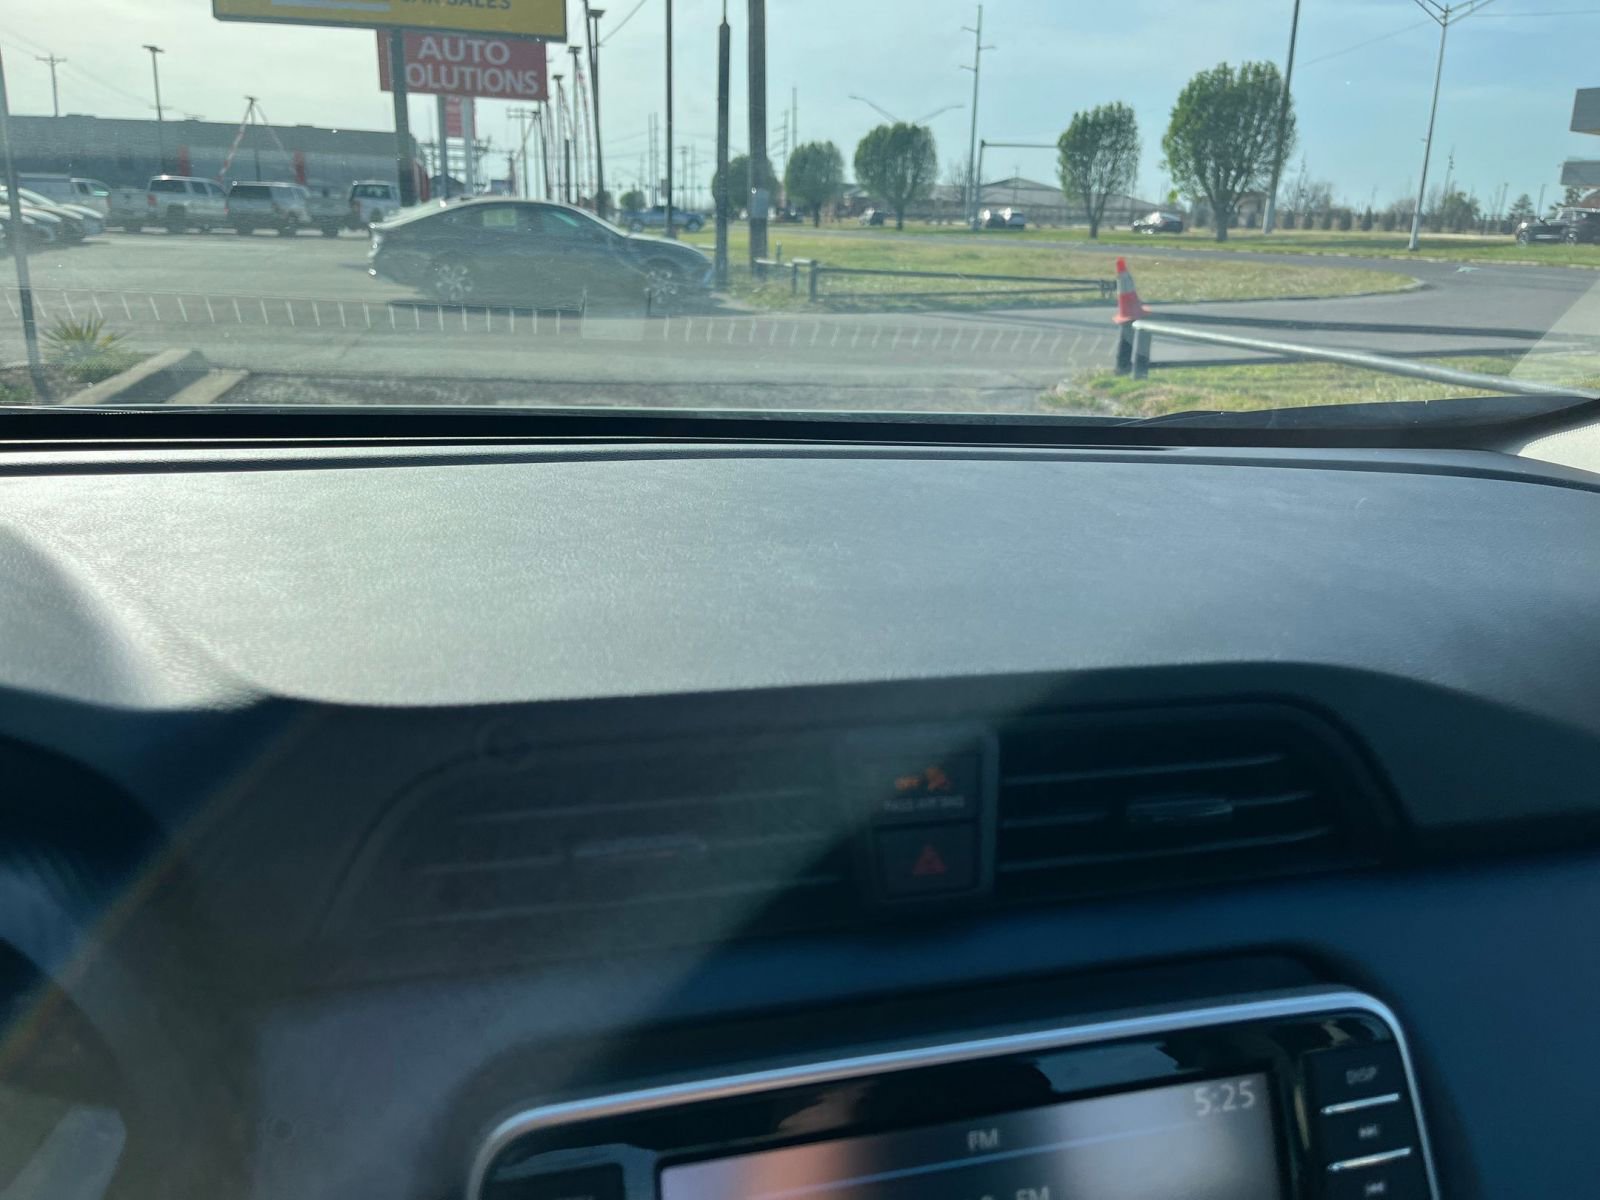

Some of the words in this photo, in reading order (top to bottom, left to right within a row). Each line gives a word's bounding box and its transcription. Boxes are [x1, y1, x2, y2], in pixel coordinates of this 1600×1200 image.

[418, 36, 510, 65] AUTO
[405, 62, 539, 94] OLUTIONS
[1194, 1080, 1255, 1116] 5:25
[967, 1128, 999, 1151] FM
